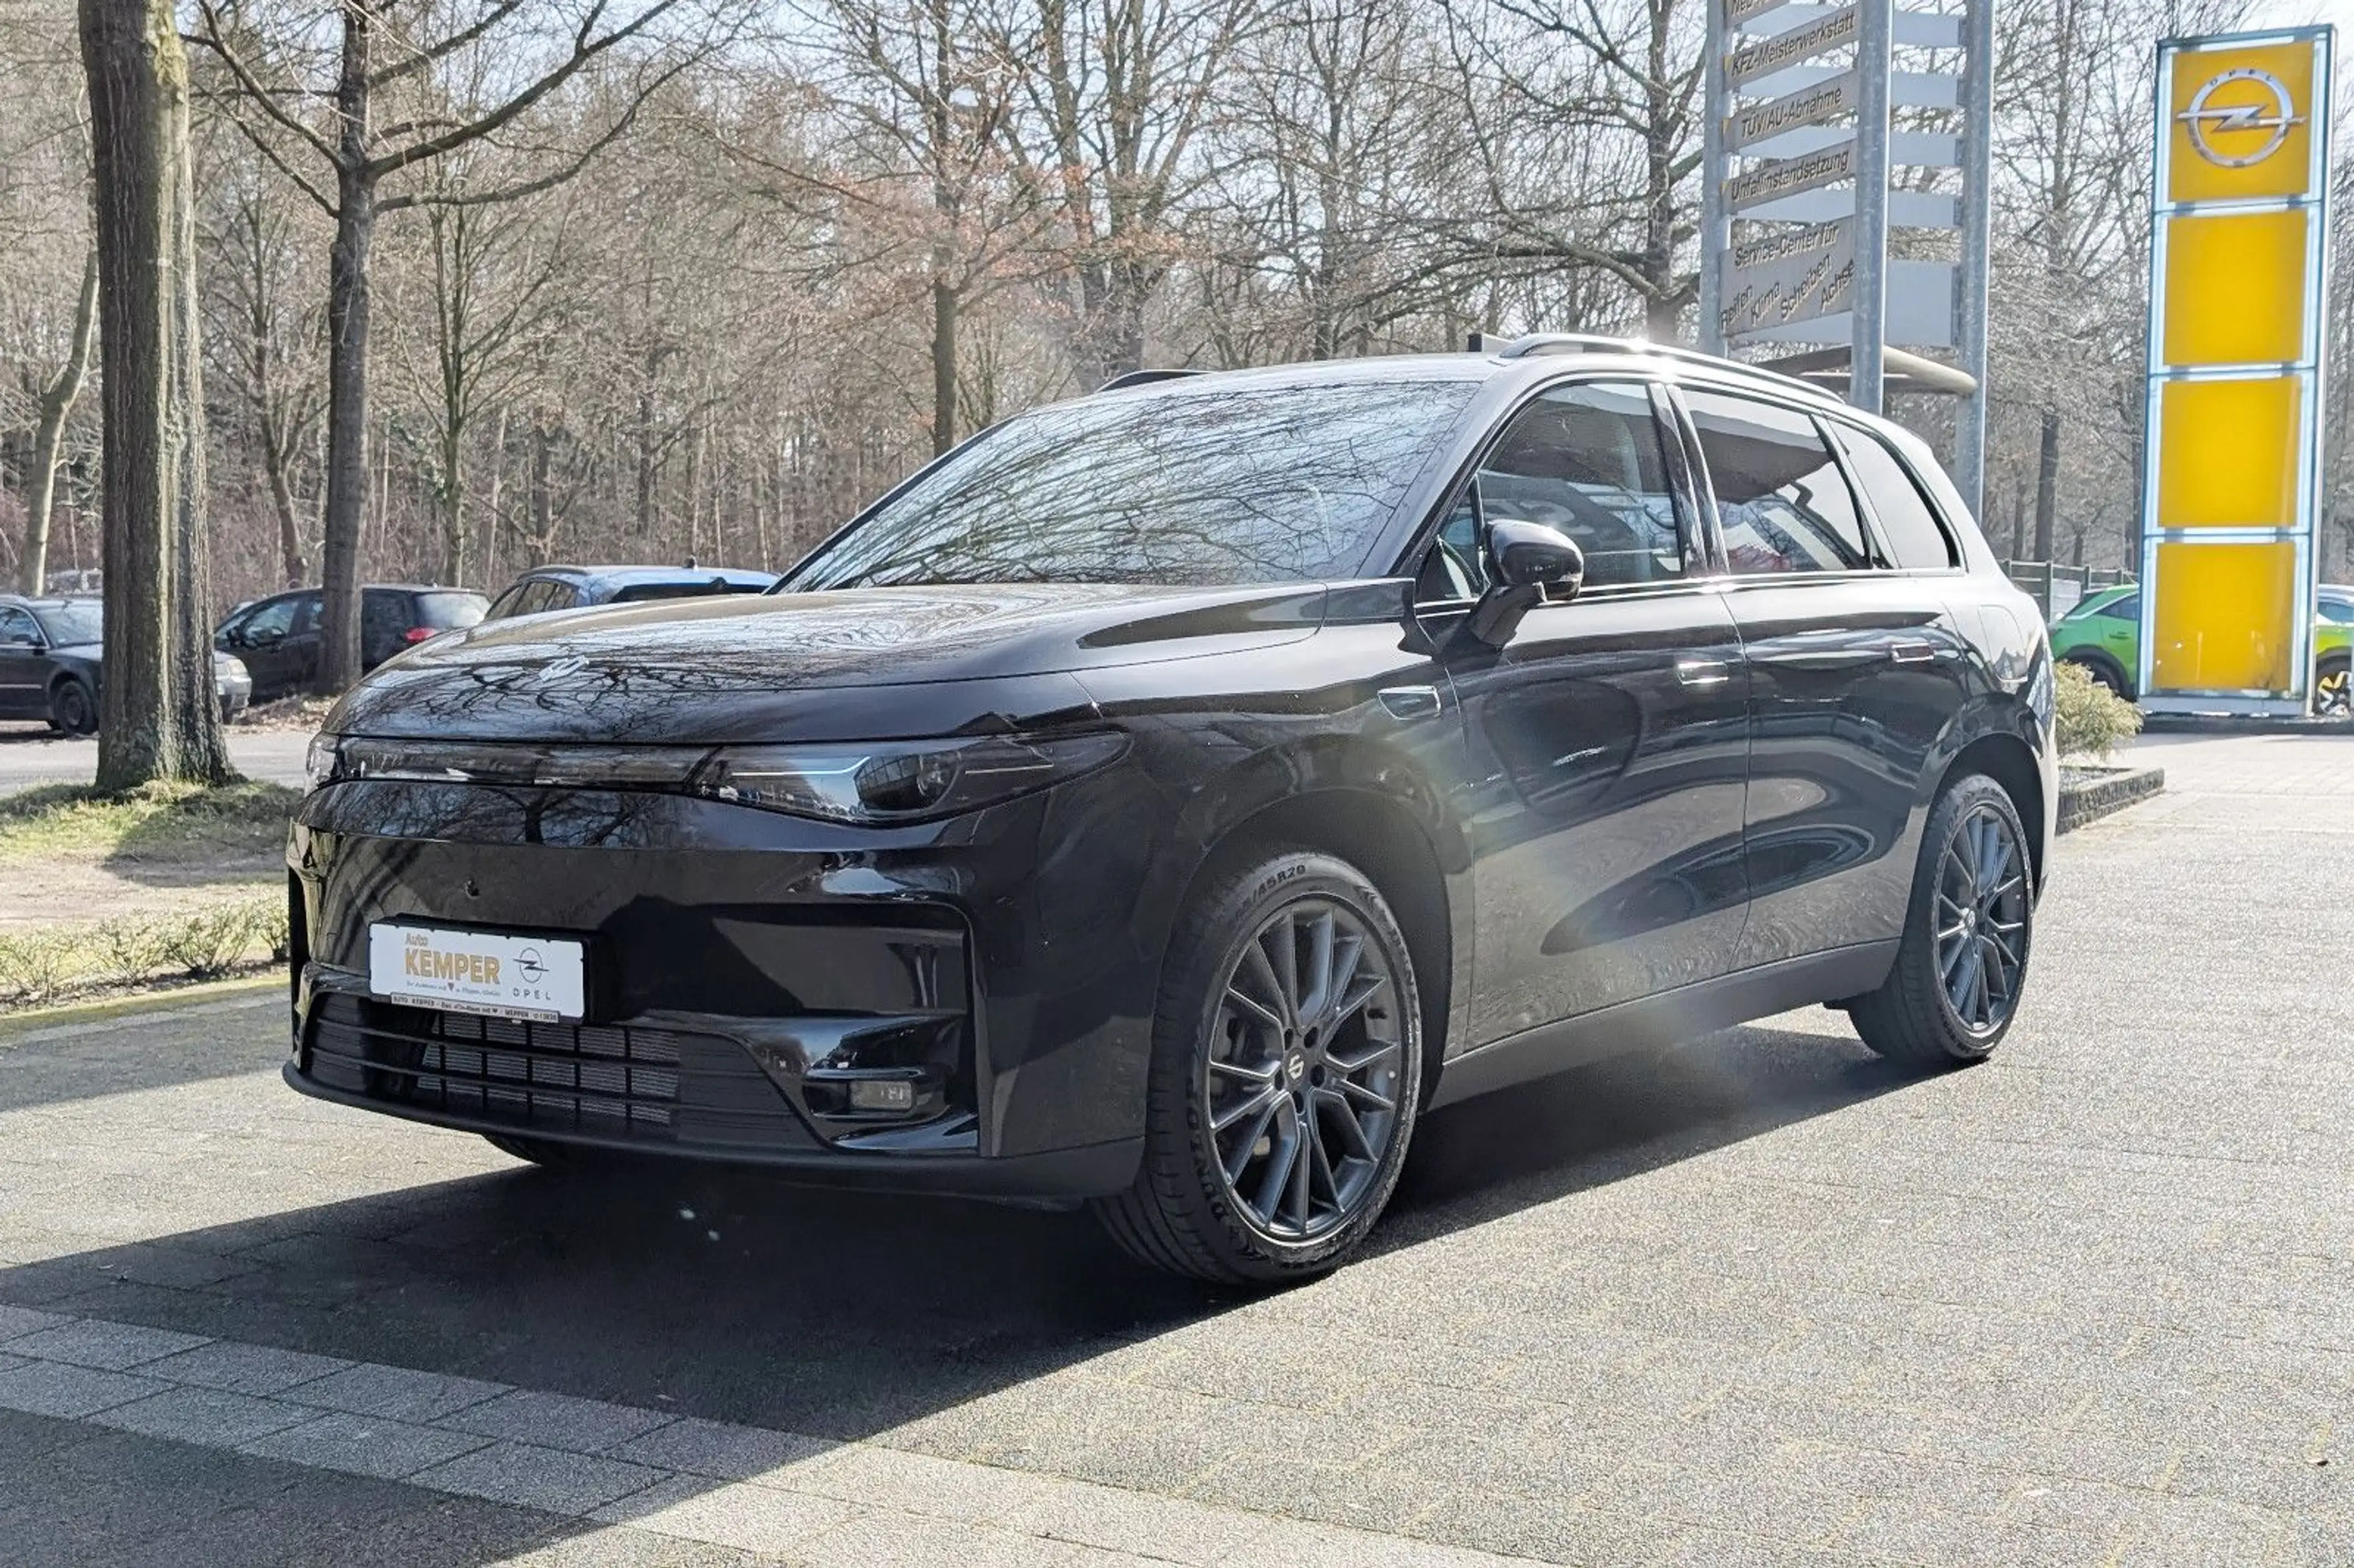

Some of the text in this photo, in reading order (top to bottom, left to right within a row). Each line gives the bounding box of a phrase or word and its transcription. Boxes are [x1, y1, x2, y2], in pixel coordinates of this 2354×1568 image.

[1732, 10, 1855, 78] KFZ-Meisterwerkstatt
[2209, 69, 2272, 86] OPEL
[1732, 149, 1849, 201] Unfallinstandsetzung
[1735, 222, 1839, 268] Service-Center für
[1721, 284, 1753, 333] Reifen
[1751, 281, 1781, 326] Klima
[405, 933, 428, 946] Auto
[405, 948, 501, 985] KEMPER
[513, 988, 551, 1000] OPEL
